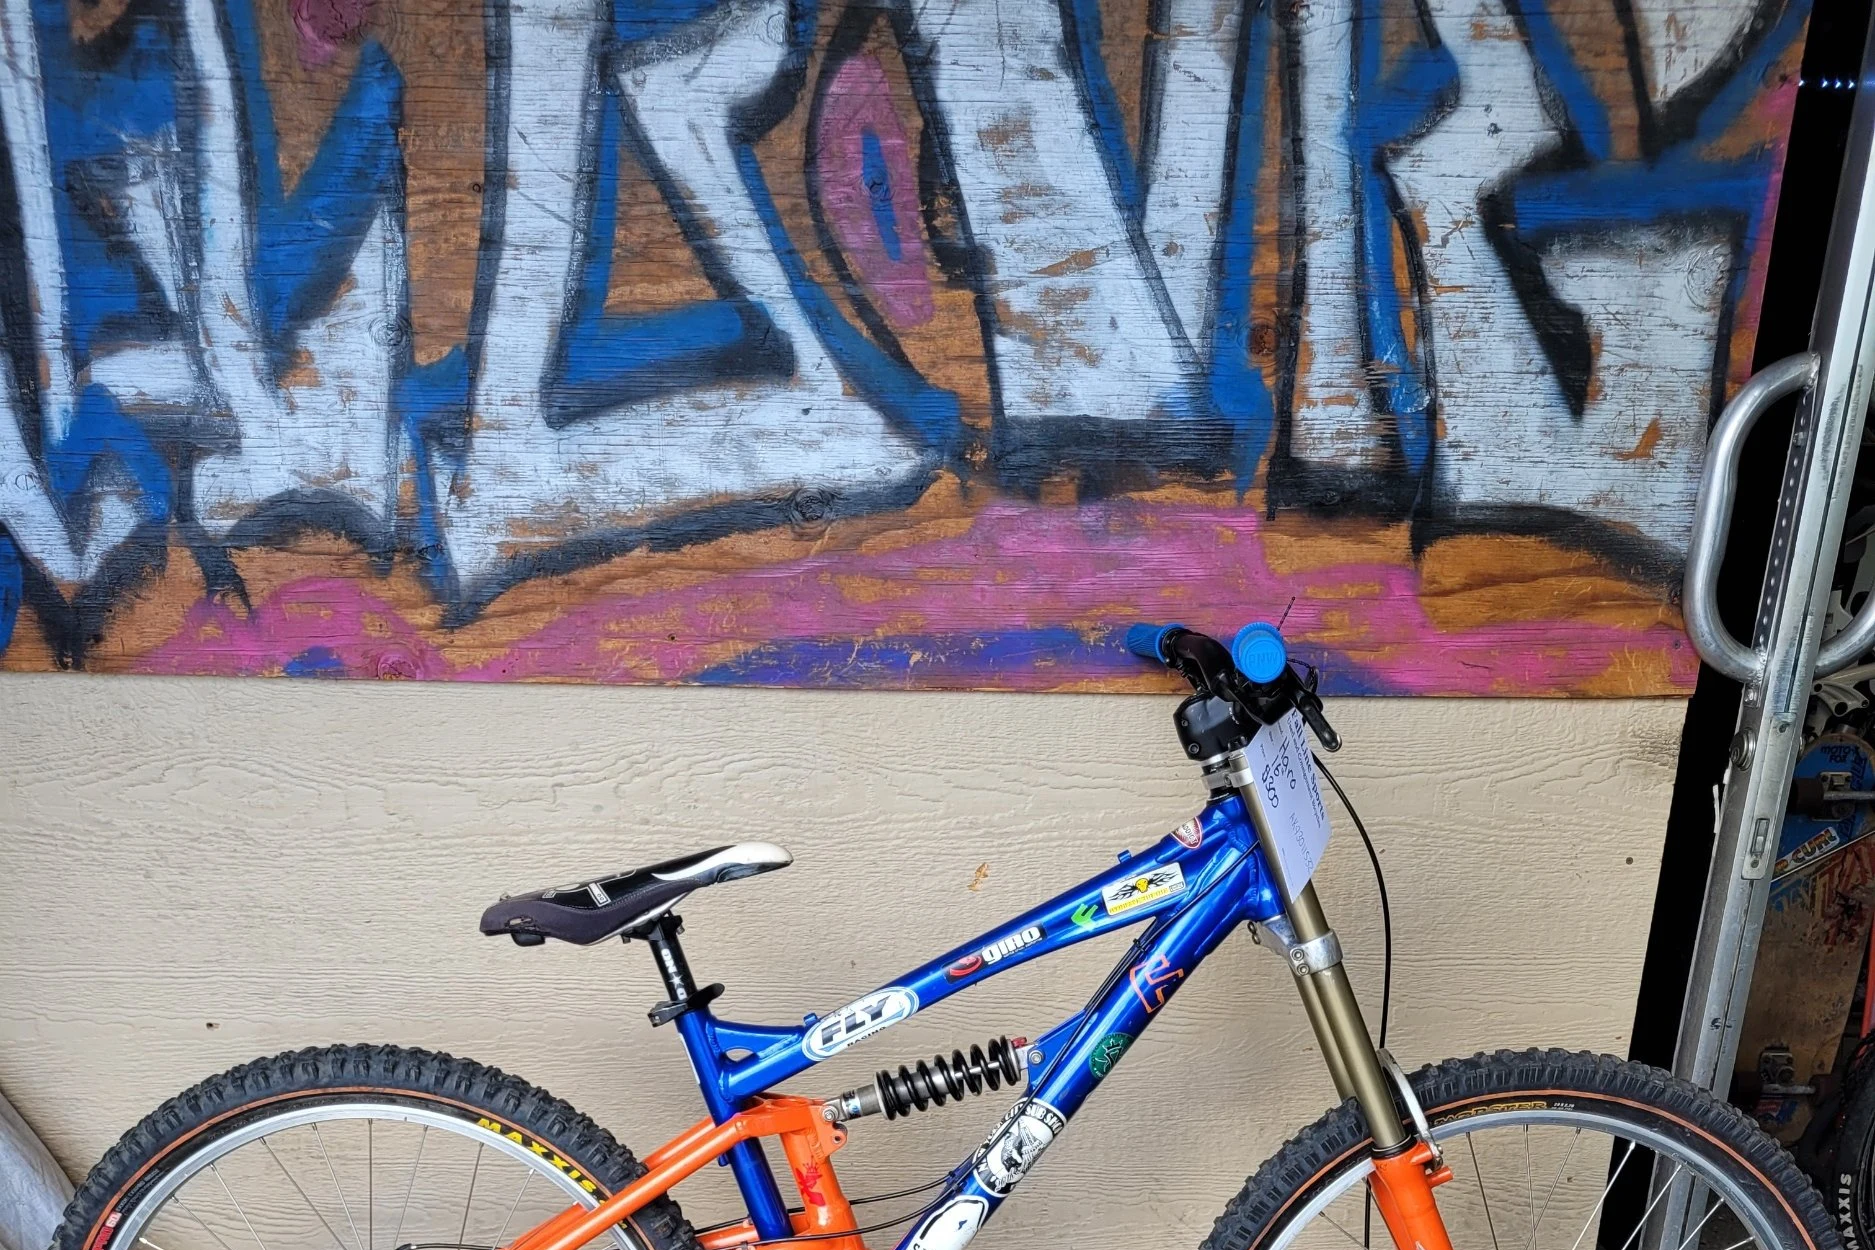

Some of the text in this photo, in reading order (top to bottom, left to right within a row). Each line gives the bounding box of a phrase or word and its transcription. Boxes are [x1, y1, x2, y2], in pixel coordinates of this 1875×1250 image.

[1248, 651, 1279, 668] PNW
[1286, 716, 1294, 737] Used
[1278, 735, 1297, 791] Haro
[1291, 709, 1326, 822] Fall Line Sports
[1261, 763, 1280, 809] $300
[821, 994, 892, 1046] FLY
[846, 1026, 887, 1047] RACING
[1025, 1103, 1046, 1121] SUB
[1043, 1109, 1065, 1134] SHO
